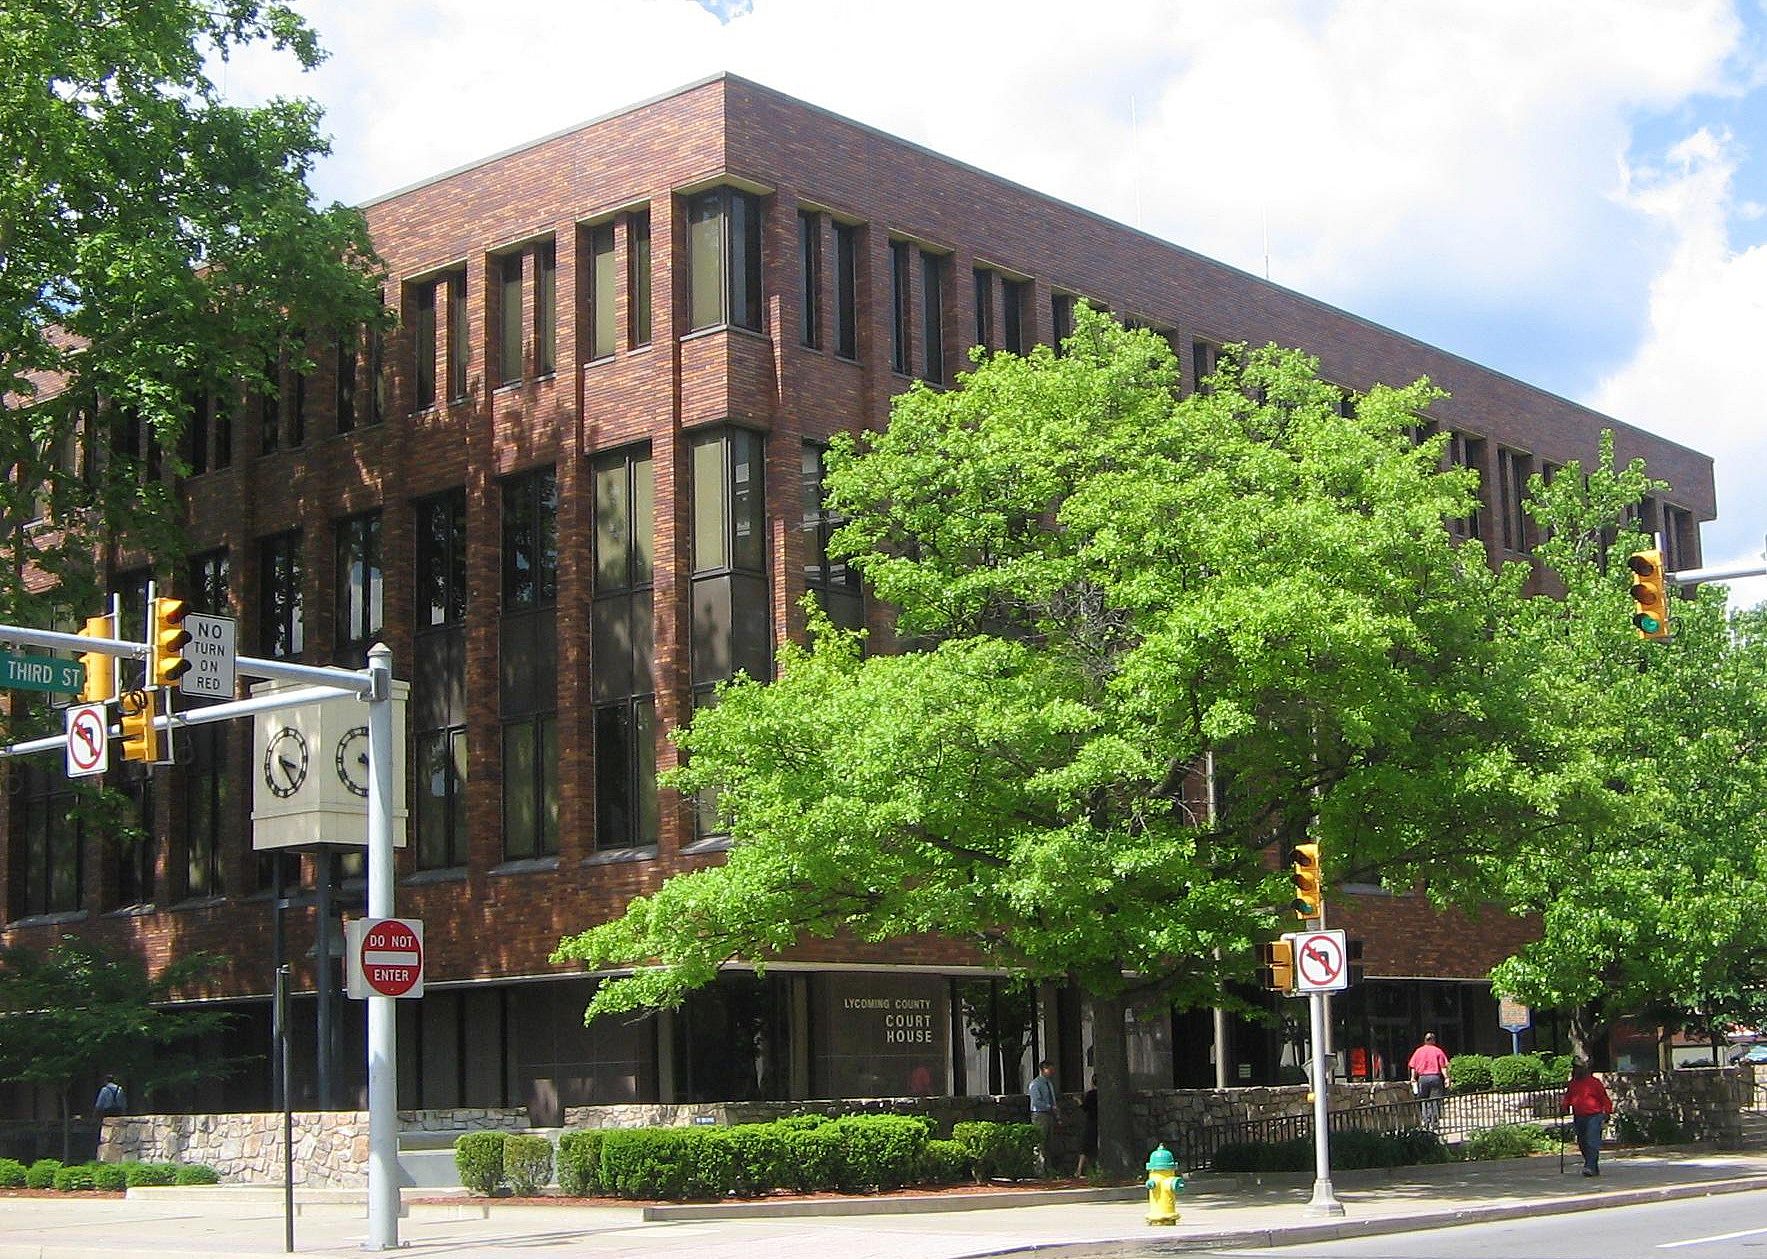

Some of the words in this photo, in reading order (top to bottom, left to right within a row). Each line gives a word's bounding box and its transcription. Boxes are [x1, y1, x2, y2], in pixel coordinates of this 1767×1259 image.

[198, 622, 222, 639] NO
[194, 641, 225, 657] TURN
[200, 660, 218, 673] ON
[8, 660, 53, 684] THIRD
[62, 667, 80, 687] ST
[197, 676, 220, 690] RED
[369, 935, 385, 947] DO
[391, 935, 413, 948] NOT
[374, 968, 409, 981] ENTER
[844, 998, 890, 1009] LYCOMING
[895, 999, 931, 1009] COUNTY
[886, 1014, 931, 1027] COURT
[886, 1030, 932, 1043] HOUSE
